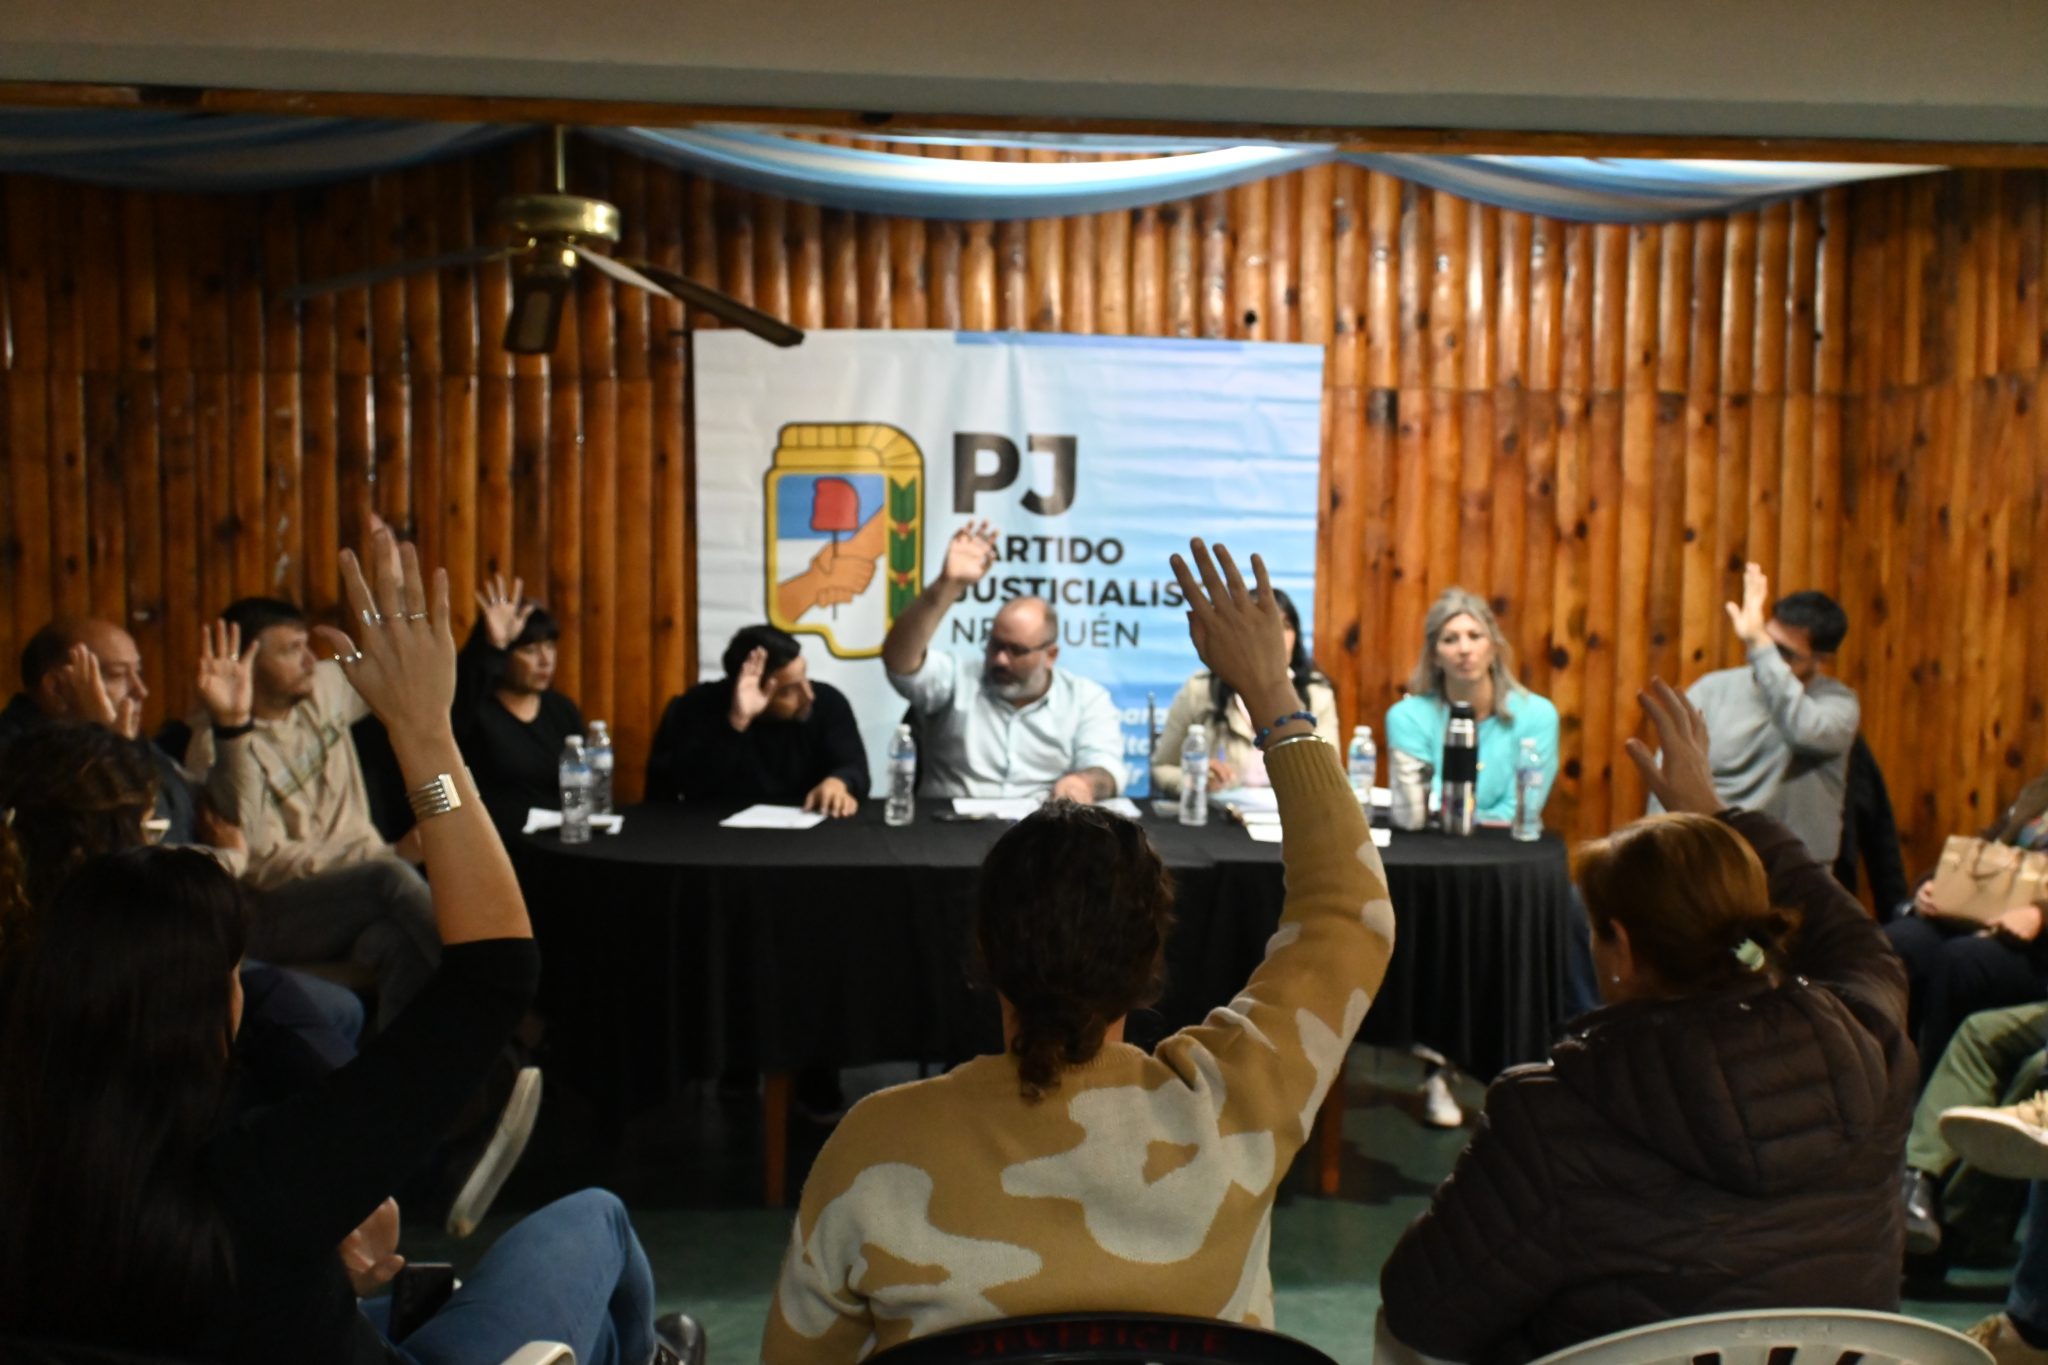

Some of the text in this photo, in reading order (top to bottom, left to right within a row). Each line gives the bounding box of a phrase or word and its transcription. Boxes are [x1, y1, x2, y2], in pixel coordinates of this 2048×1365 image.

[953, 432, 1078, 516] PJ
[990, 535, 1124, 566] RTIDO
[956, 576, 1186, 608] JUSTICIALIS
